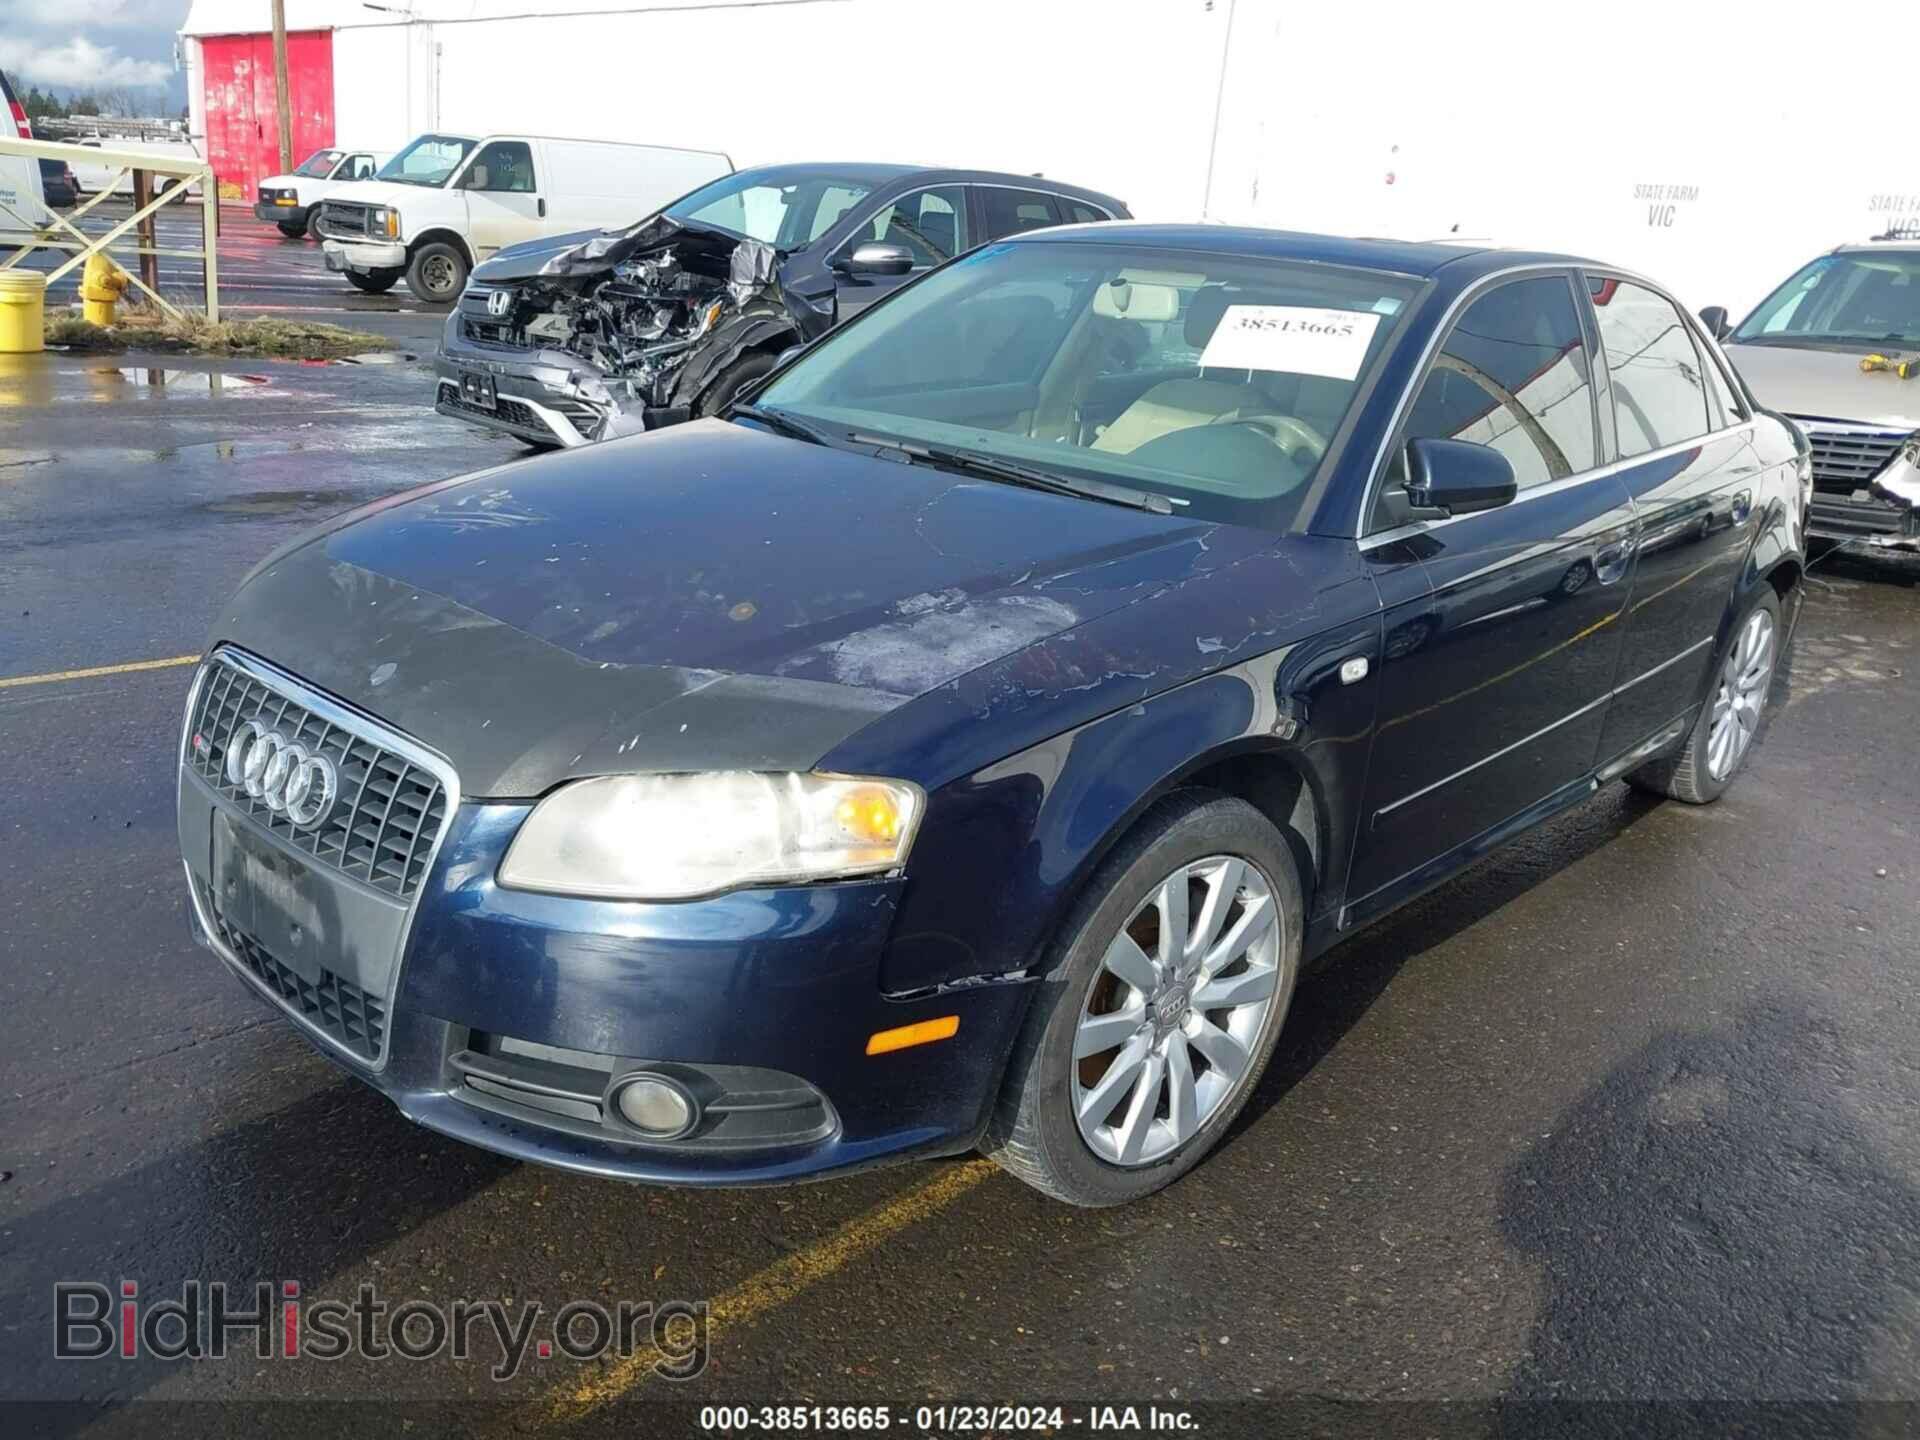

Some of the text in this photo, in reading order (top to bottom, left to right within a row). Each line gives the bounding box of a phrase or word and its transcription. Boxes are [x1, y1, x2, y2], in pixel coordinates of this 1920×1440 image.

[1633, 184, 1699, 200] STATE FARM
[1869, 194, 1905, 211] STATE
[1648, 204, 1676, 227] VIC
[1233, 317, 1355, 337] 38513665
